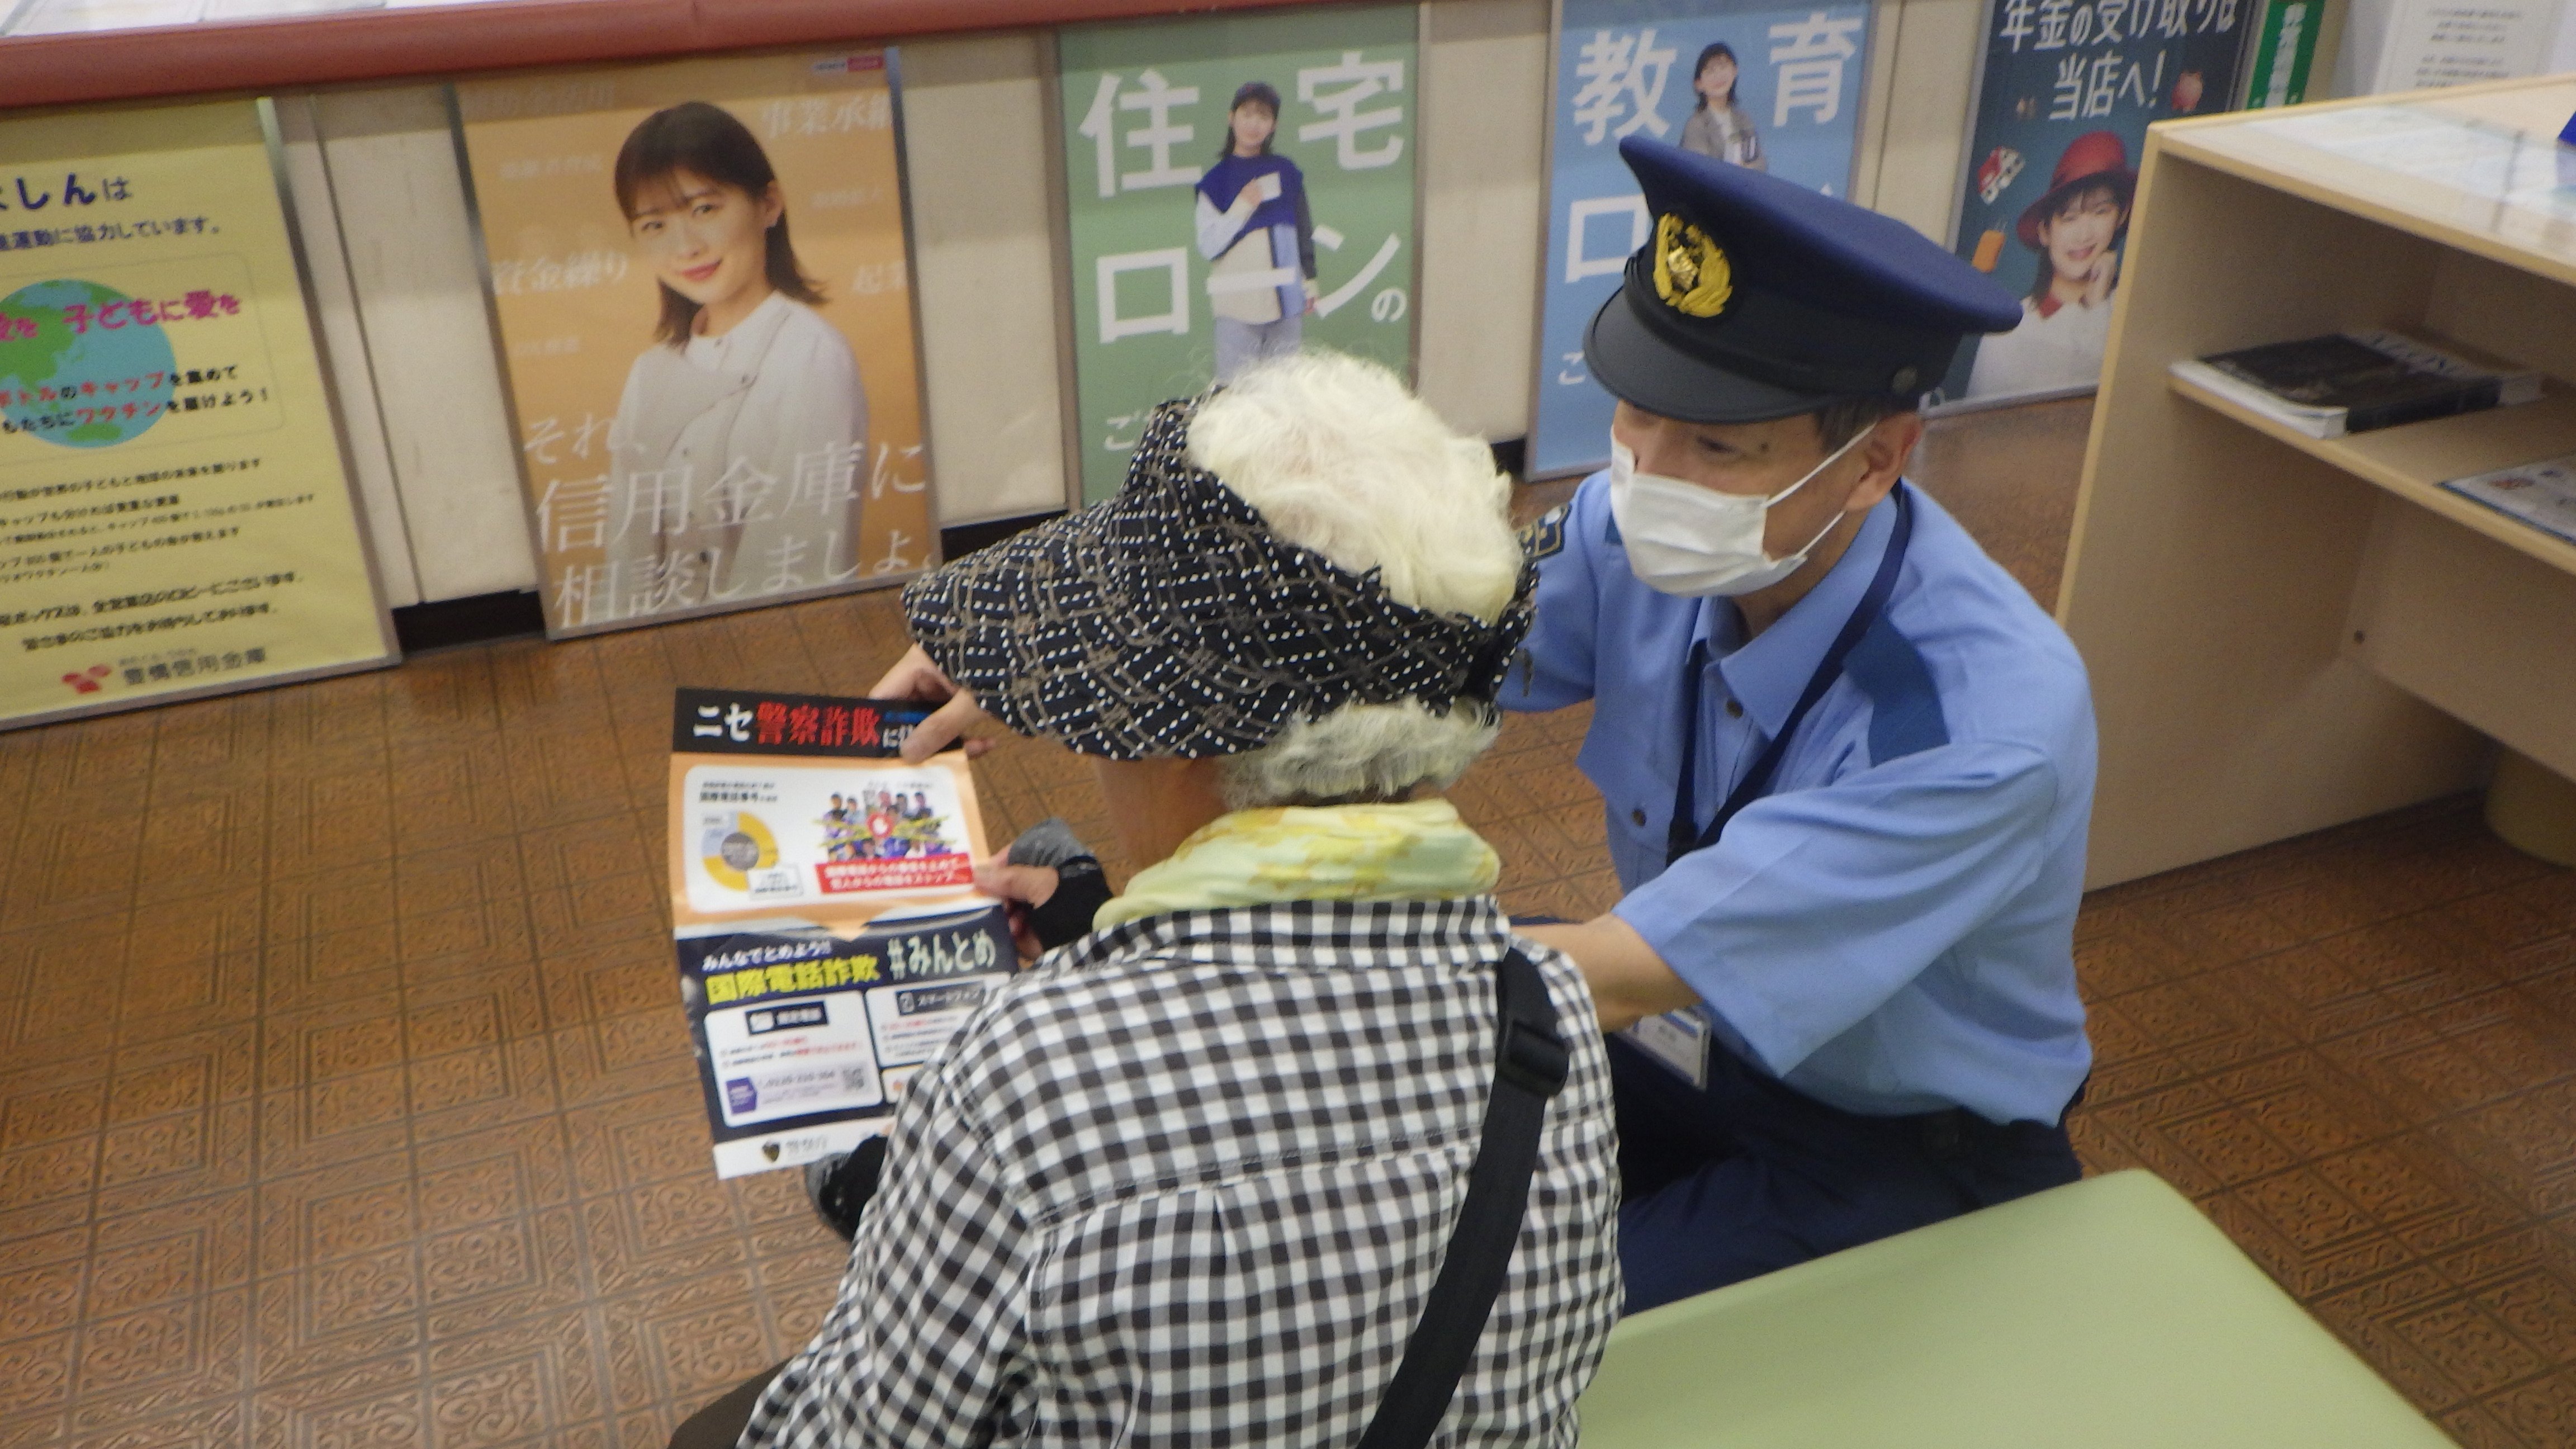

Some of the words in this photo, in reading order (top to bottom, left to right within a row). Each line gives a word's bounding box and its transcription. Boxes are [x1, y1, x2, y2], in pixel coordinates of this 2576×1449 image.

[1079, 51, 1405, 199] 住宅
[0, 173, 133, 210] しんは
[1096, 225, 1409, 344] ローンの
[536, 439, 926, 553] 信用金庫に
[554, 528, 932, 627] 相談しましょ
[705, 954, 880, 1005] 国際電話詐欺
